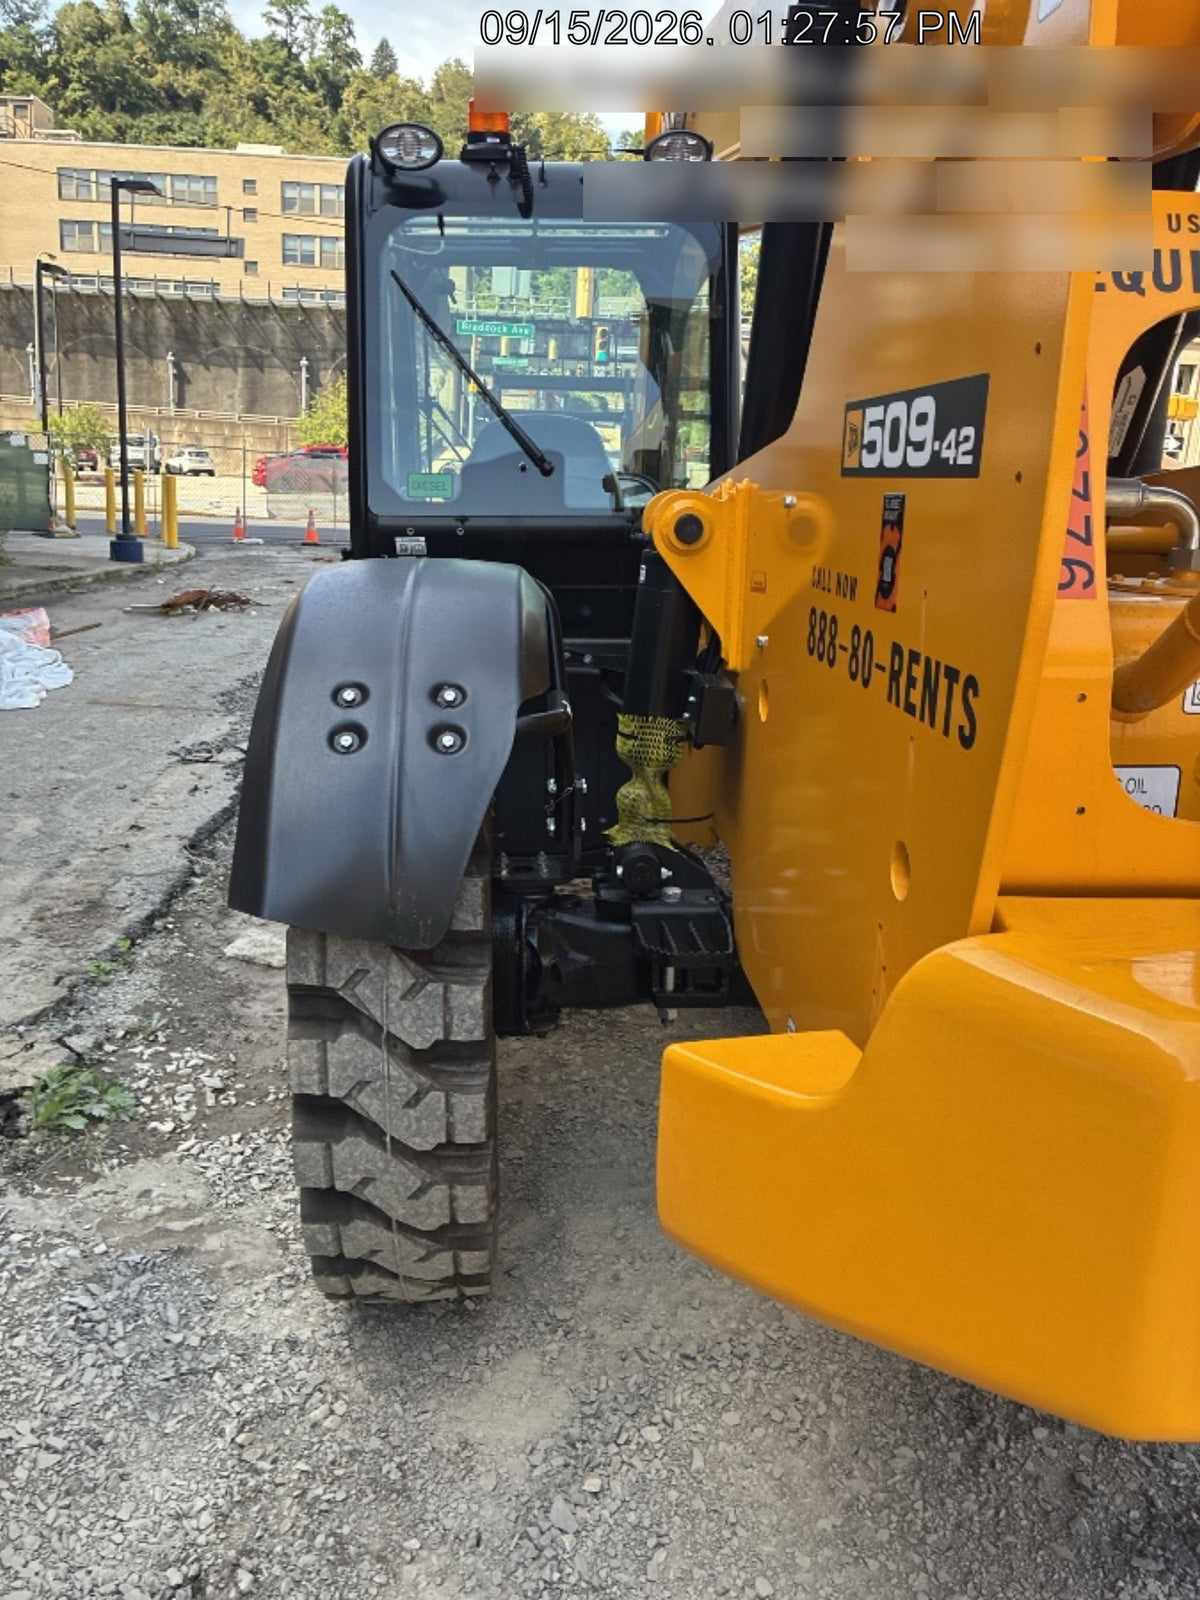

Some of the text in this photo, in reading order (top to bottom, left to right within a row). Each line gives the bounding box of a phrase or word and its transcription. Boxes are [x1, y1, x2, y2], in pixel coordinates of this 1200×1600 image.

[411, 481, 448, 492] DIESEL
[812, 566, 858, 602] CALL NOW
[807, 605, 980, 751] 888-80-RENTS
[1125, 776, 1148, 795] OIL
